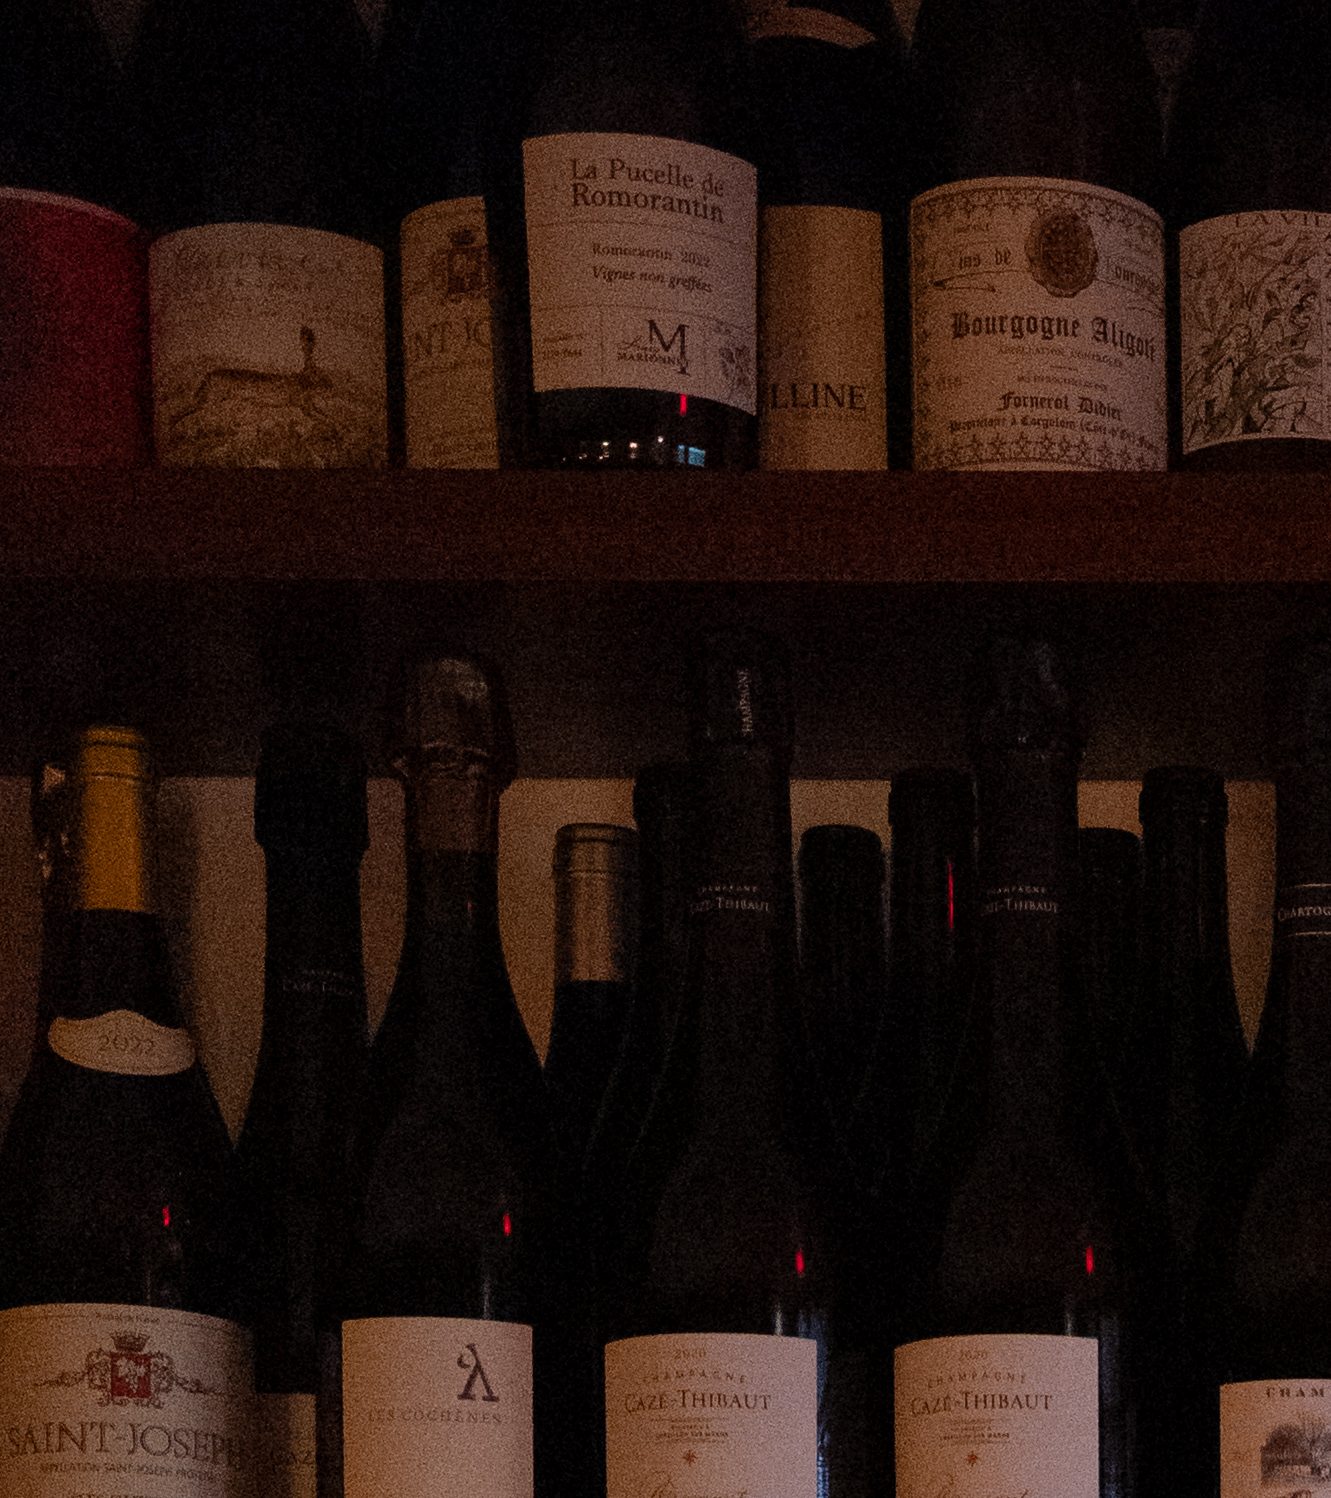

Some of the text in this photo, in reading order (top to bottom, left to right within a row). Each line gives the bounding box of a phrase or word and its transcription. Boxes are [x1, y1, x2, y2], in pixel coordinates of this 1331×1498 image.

[571, 158, 724, 197] La Pucelle de
[571, 183, 724, 223] Romorantin
[593, 266, 635, 282] Vignes
[951, 311, 1079, 340] Bourgogne
[642, 1370, 747, 1384] CHAMPAGNE
[928, 1371, 1026, 1388] CHAMPAGNE
